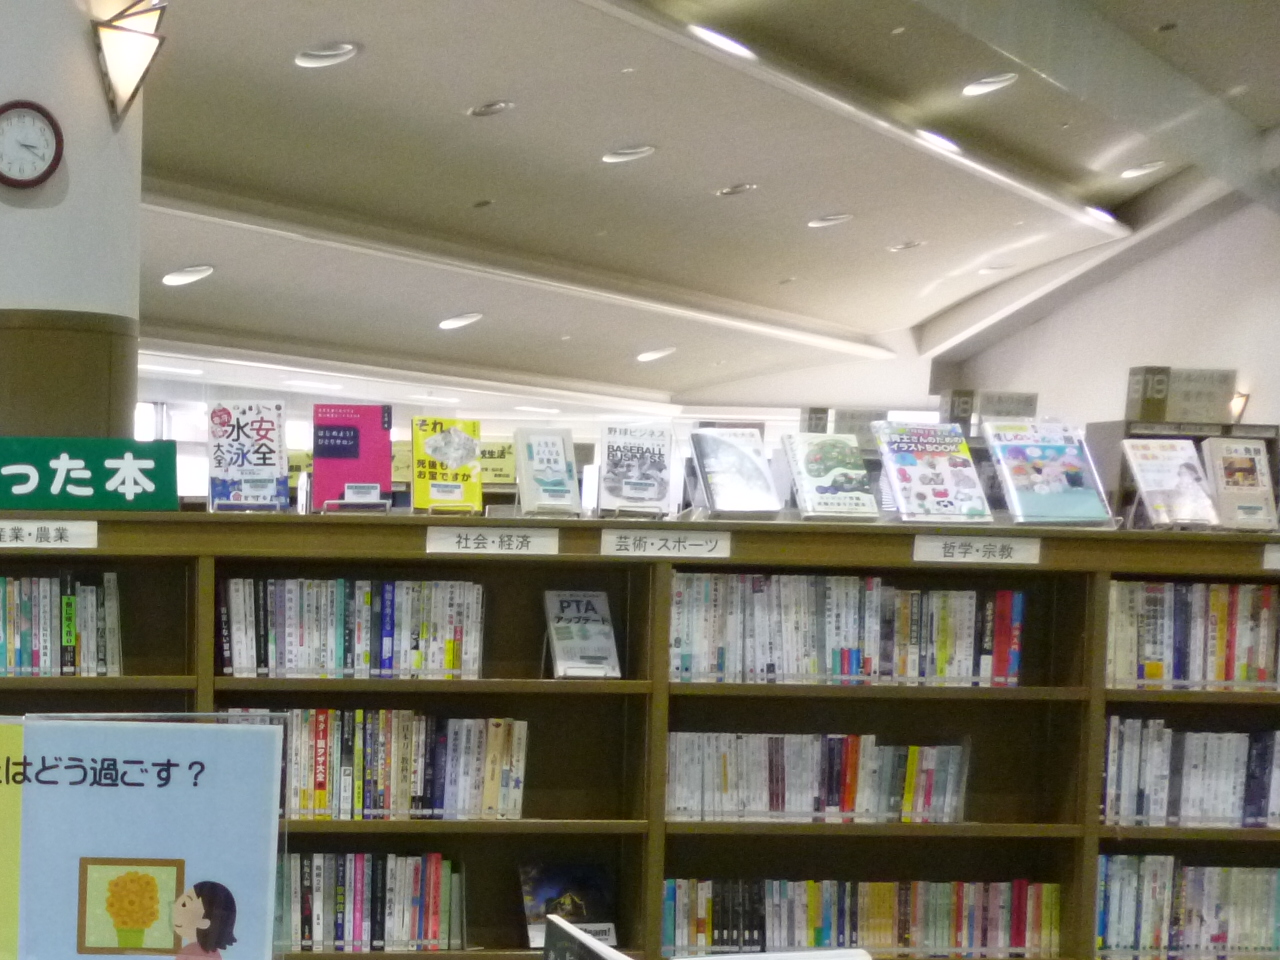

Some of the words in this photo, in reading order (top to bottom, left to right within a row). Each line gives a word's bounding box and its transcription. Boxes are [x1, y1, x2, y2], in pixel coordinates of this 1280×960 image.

[455, 534, 532, 551] 社会・経済
[615, 535, 719, 553] 芸術・スポーツ
[941, 541, 1014, 560] 哲学・宗教
[559, 600, 598, 615] PTA
